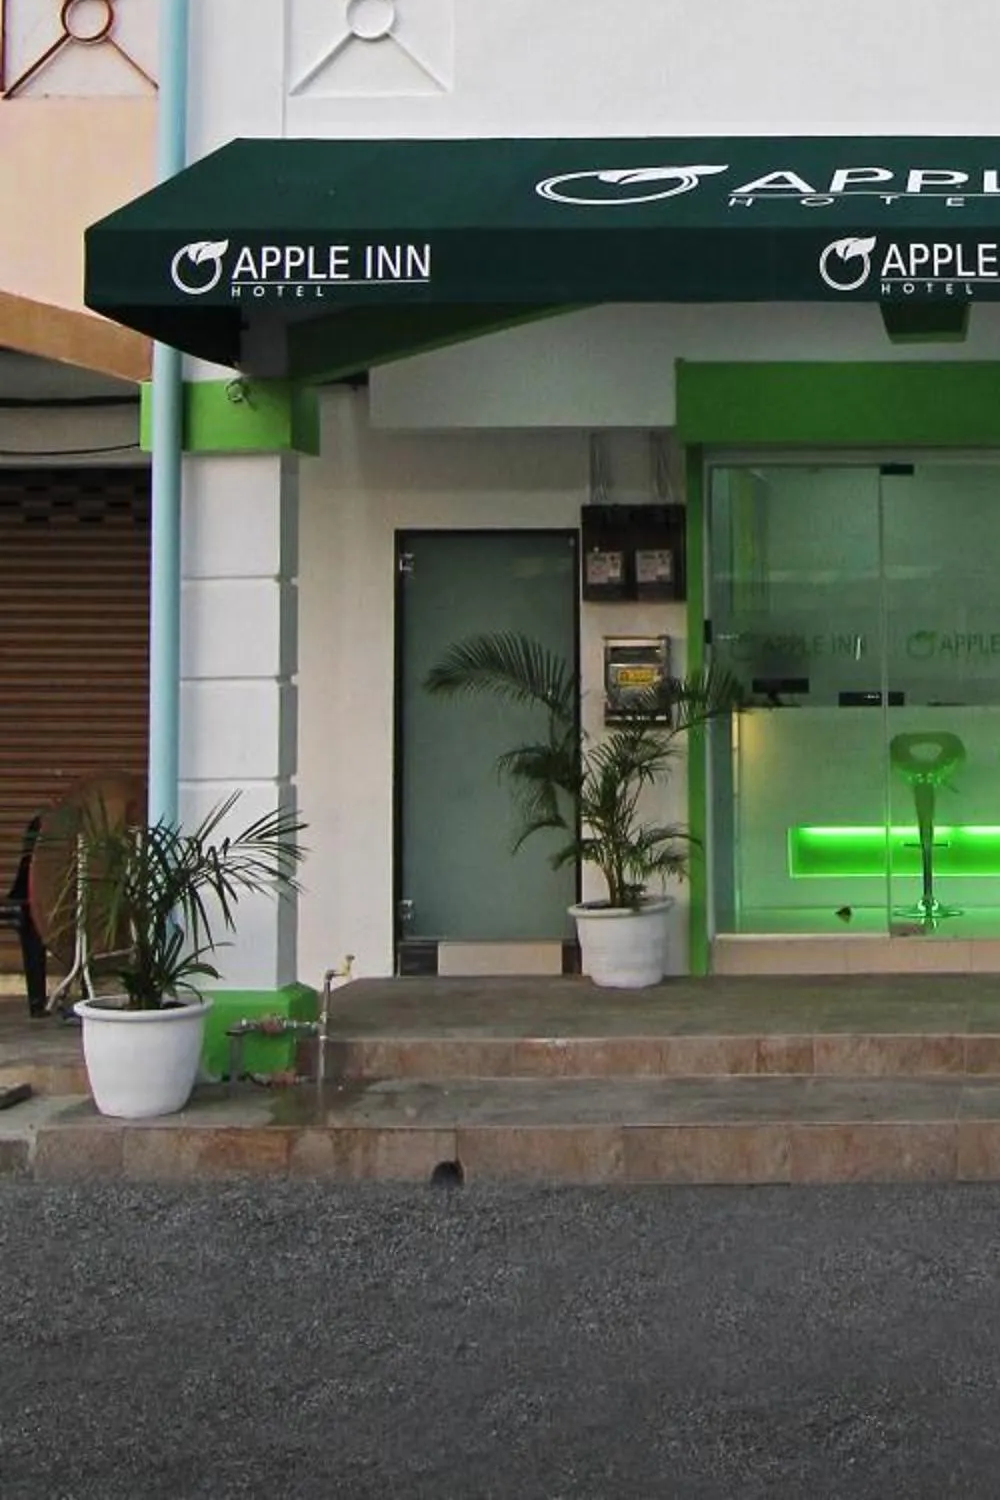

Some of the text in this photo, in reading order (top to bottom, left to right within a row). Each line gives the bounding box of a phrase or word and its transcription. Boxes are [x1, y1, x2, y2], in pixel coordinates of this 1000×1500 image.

[231, 244, 431, 280] APPLE INN
[881, 243, 999, 278] APPLE
[231, 285, 324, 298] HOTEL
[881, 282, 974, 296] HOTEL
